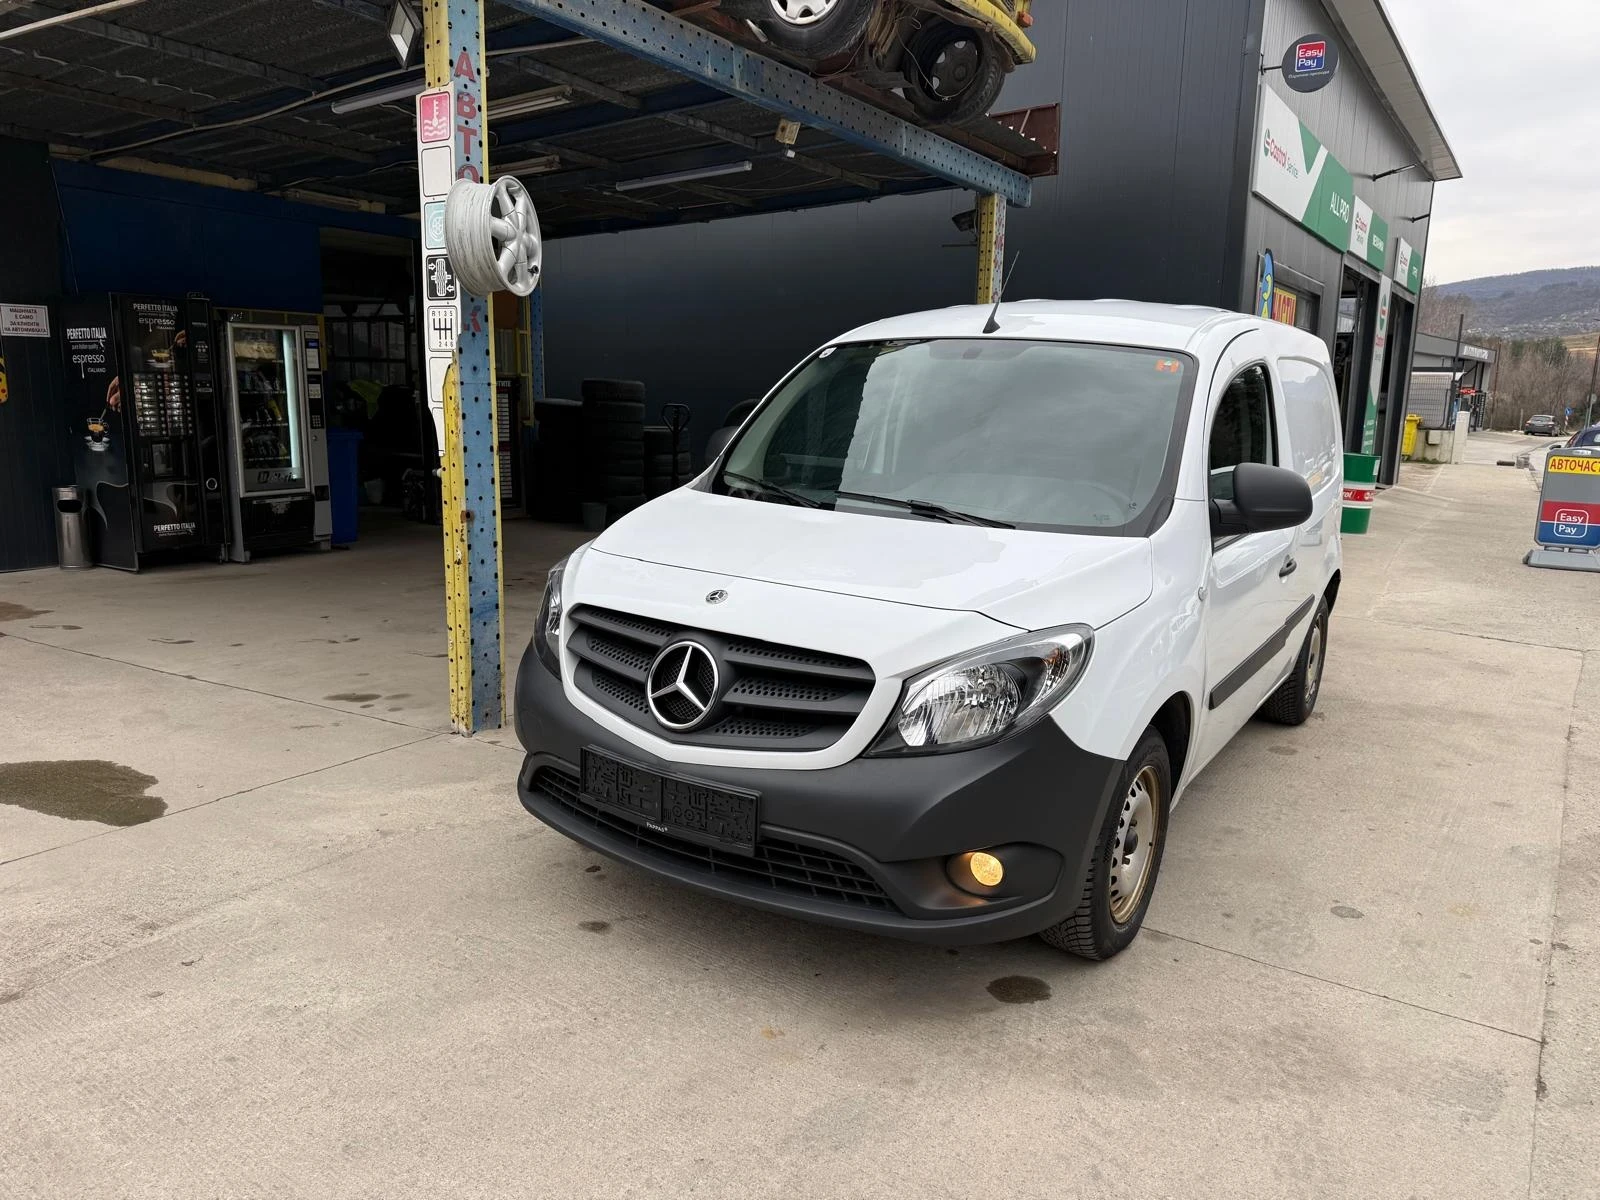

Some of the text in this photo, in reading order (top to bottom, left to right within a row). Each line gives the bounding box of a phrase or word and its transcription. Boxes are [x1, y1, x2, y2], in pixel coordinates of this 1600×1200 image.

[1299, 48, 1323, 58] Easy
[1298, 58, 1317, 68] Pay
[1270, 138, 1287, 168] Castrol
[1330, 191, 1350, 224] ALL PRO
[133, 303, 161, 311] PERFETTO
[66, 327, 107, 339] PERFETTO ITALIA
[1550, 458, 1600, 472] АВТОЧАС
[1560, 513, 1584, 524] Easy
[1558, 524, 1577, 535] Pay
